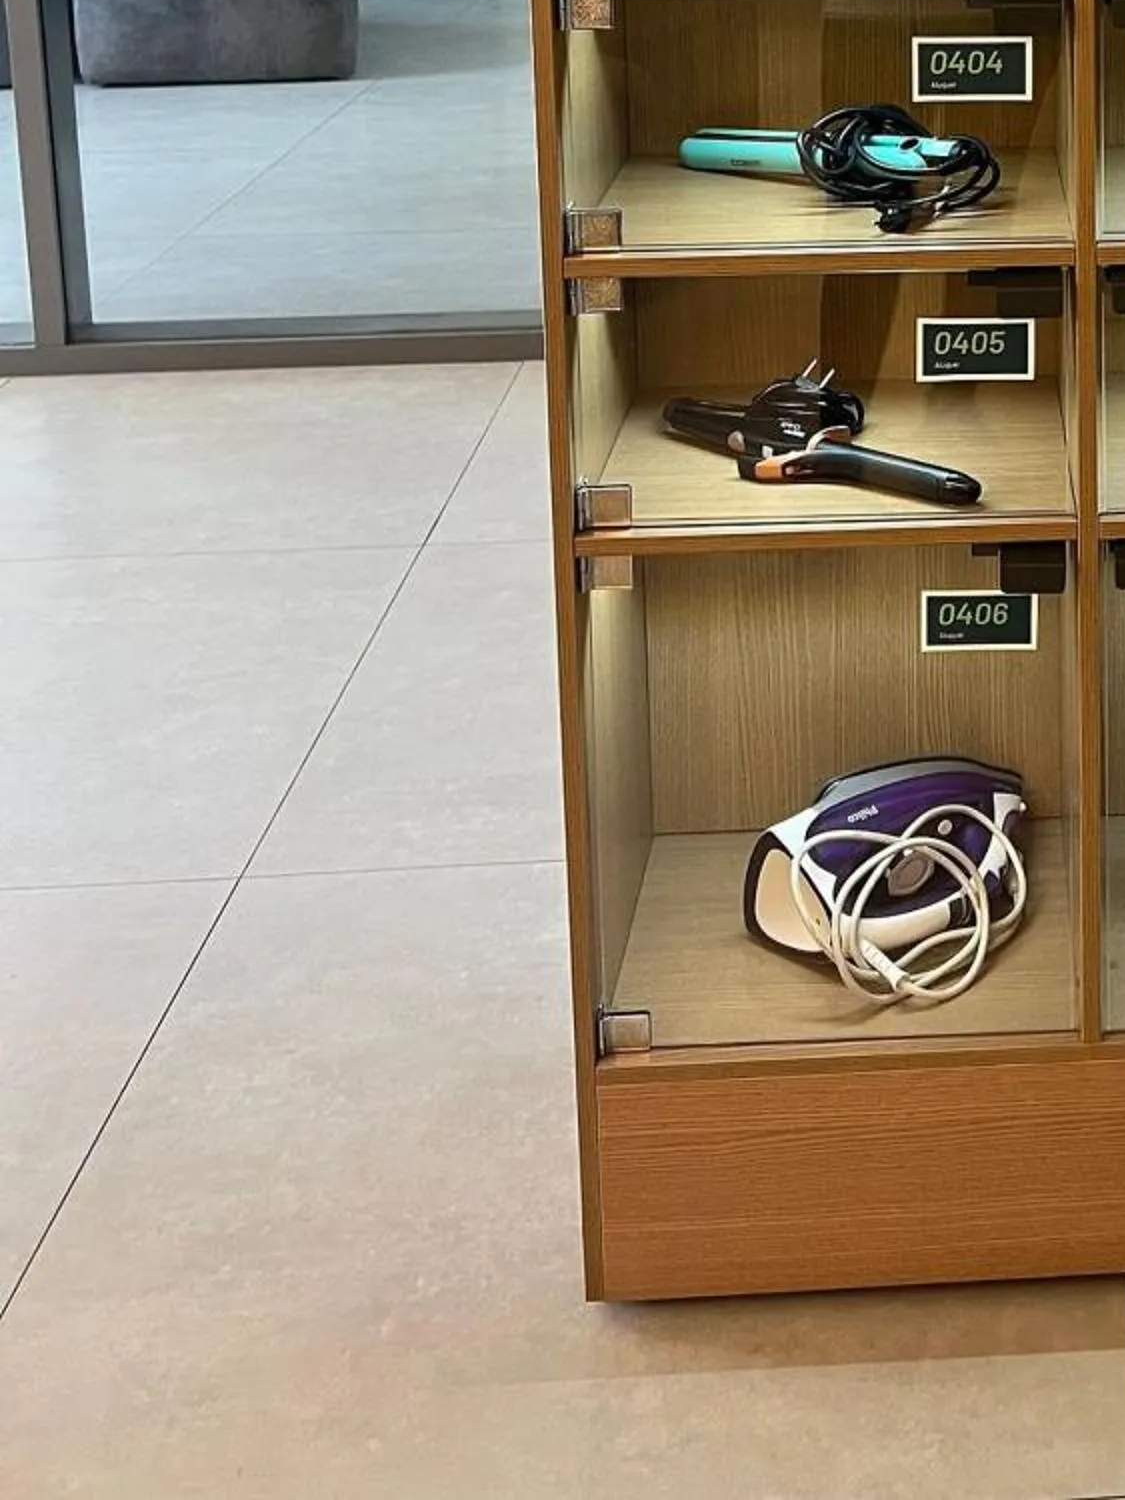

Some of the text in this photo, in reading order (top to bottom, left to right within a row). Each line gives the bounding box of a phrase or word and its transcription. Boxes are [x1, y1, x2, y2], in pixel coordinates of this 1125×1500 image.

[930, 50, 1003, 75] 0404
[934, 330, 1006, 355] 0405
[938, 602, 1009, 626] 0406
